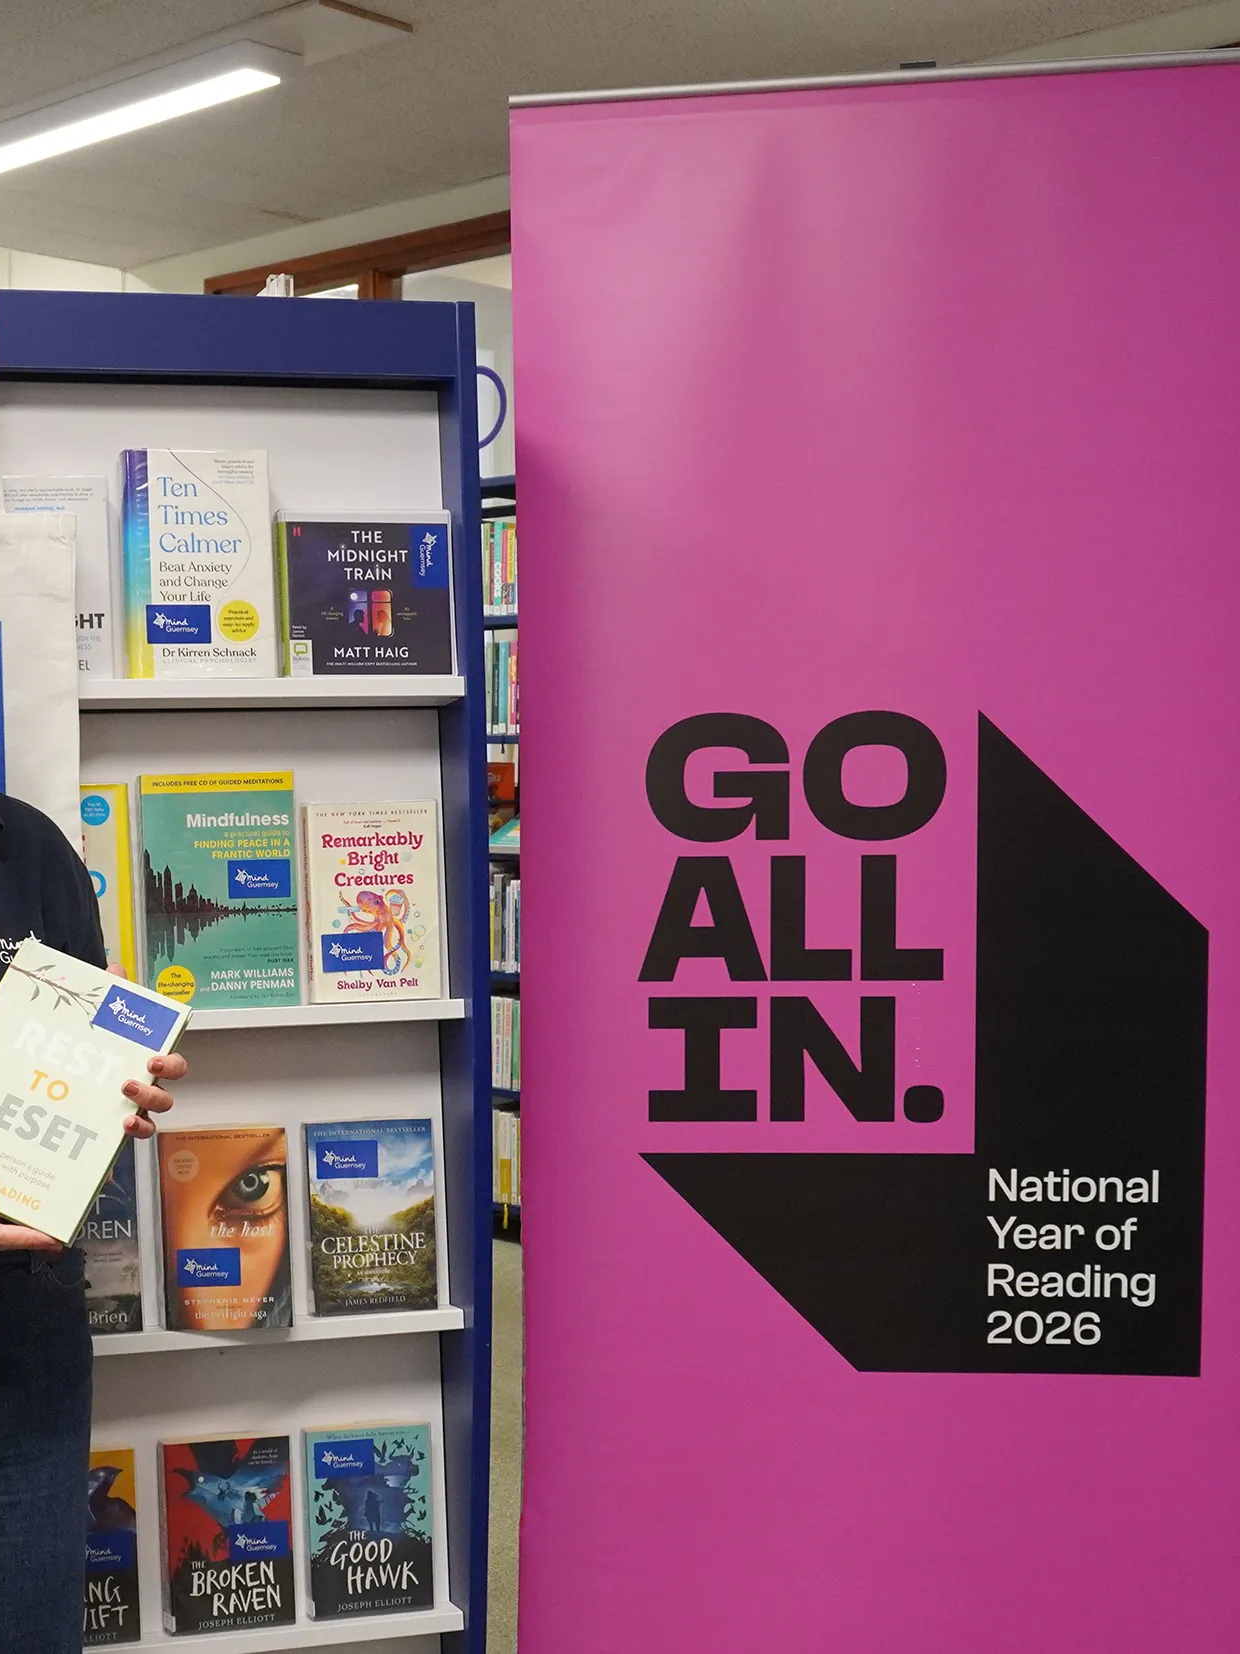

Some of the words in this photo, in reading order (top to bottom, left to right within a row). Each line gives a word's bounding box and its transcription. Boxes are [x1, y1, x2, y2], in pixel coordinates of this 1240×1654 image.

[157, 477, 198, 497] Ten
[158, 505, 228, 525] Times
[160, 532, 241, 553] Calmer
[351, 531, 383, 543] THE
[328, 547, 408, 562] MIDNIGHT
[160, 562, 185, 572] Beat
[188, 562, 232, 575] Anxiety
[344, 565, 392, 580] TRAIN
[160, 576, 181, 586] and
[184, 576, 228, 588] Change
[160, 591, 187, 601] Your
[190, 591, 211, 601] Life
[166, 626, 198, 634] Guernsey
[162, 648, 175, 657] Dr
[178, 648, 210, 657] Kirren
[213, 648, 256, 657] Schnack
[334, 647, 370, 657] MATT
[375, 647, 408, 657] HAIG
[644, 709, 948, 843] GO
[186, 813, 289, 828] Mindfulness
[322, 831, 423, 849] Remarkably
[212, 851, 252, 859] FRANTIC
[256, 850, 290, 858] WORLD
[348, 850, 399, 871] Bright
[334, 873, 414, 886] Creatures
[637, 853, 945, 983] ALL
[341, 954, 372, 962] Guernsey
[211, 971, 240, 979] MARK
[244, 968, 294, 978] WILLIAMS
[211, 982, 248, 991] DANNY
[251, 979, 294, 989] PENMAN
[337, 981, 372, 991] Shelby
[376, 979, 396, 988] Van
[400, 978, 418, 986] Pelt
[122, 1007, 146, 1024] mind
[117, 1014, 153, 1036] Guernsey
[13, 1017, 125, 1088] REST
[648, 995, 945, 1124] IN.
[29, 1069, 69, 1102] TO
[0, 1151, 32, 1171] person's
[32, 1167, 55, 1180] guide
[2, 1162, 18, 1175] with
[18, 1171, 51, 1189] purpose
[987, 1168, 1160, 1203] National
[210, 1222, 236, 1237] the
[241, 1221, 275, 1236] host
[986, 1215, 1085, 1250] Year
[1094, 1216, 1138, 1250] of
[321, 1232, 426, 1254] CELESTINE
[333, 1251, 417, 1269] PROPHECY
[196, 1271, 228, 1279] Guernsey
[986, 1263, 1156, 1307] Reading
[345, 1299, 368, 1307] JAMES
[370, 1296, 406, 1304] REDFIELD
[88, 1310, 127, 1324] Brien
[195, 1311, 209, 1319] the
[211, 1305, 247, 1320] twilight
[250, 1310, 267, 1320] saga
[986, 1310, 1102, 1345] 2026
[333, 1460, 363, 1469] Guernsey
[348, 1531, 368, 1541] THE
[246, 1544, 277, 1552] Guernsey
[330, 1538, 393, 1570] GOOD
[191, 1561, 207, 1570] THE
[190, 1560, 275, 1597] BROKEN
[347, 1561, 419, 1595] HAWK
[213, 1584, 281, 1616] RAVEN
[337, 1601, 372, 1612] JOSEPH
[375, 1597, 412, 1608] ELLIOTT
[198, 1619, 234, 1630] JOSEPH
[237, 1613, 275, 1625] ELLIOTT
